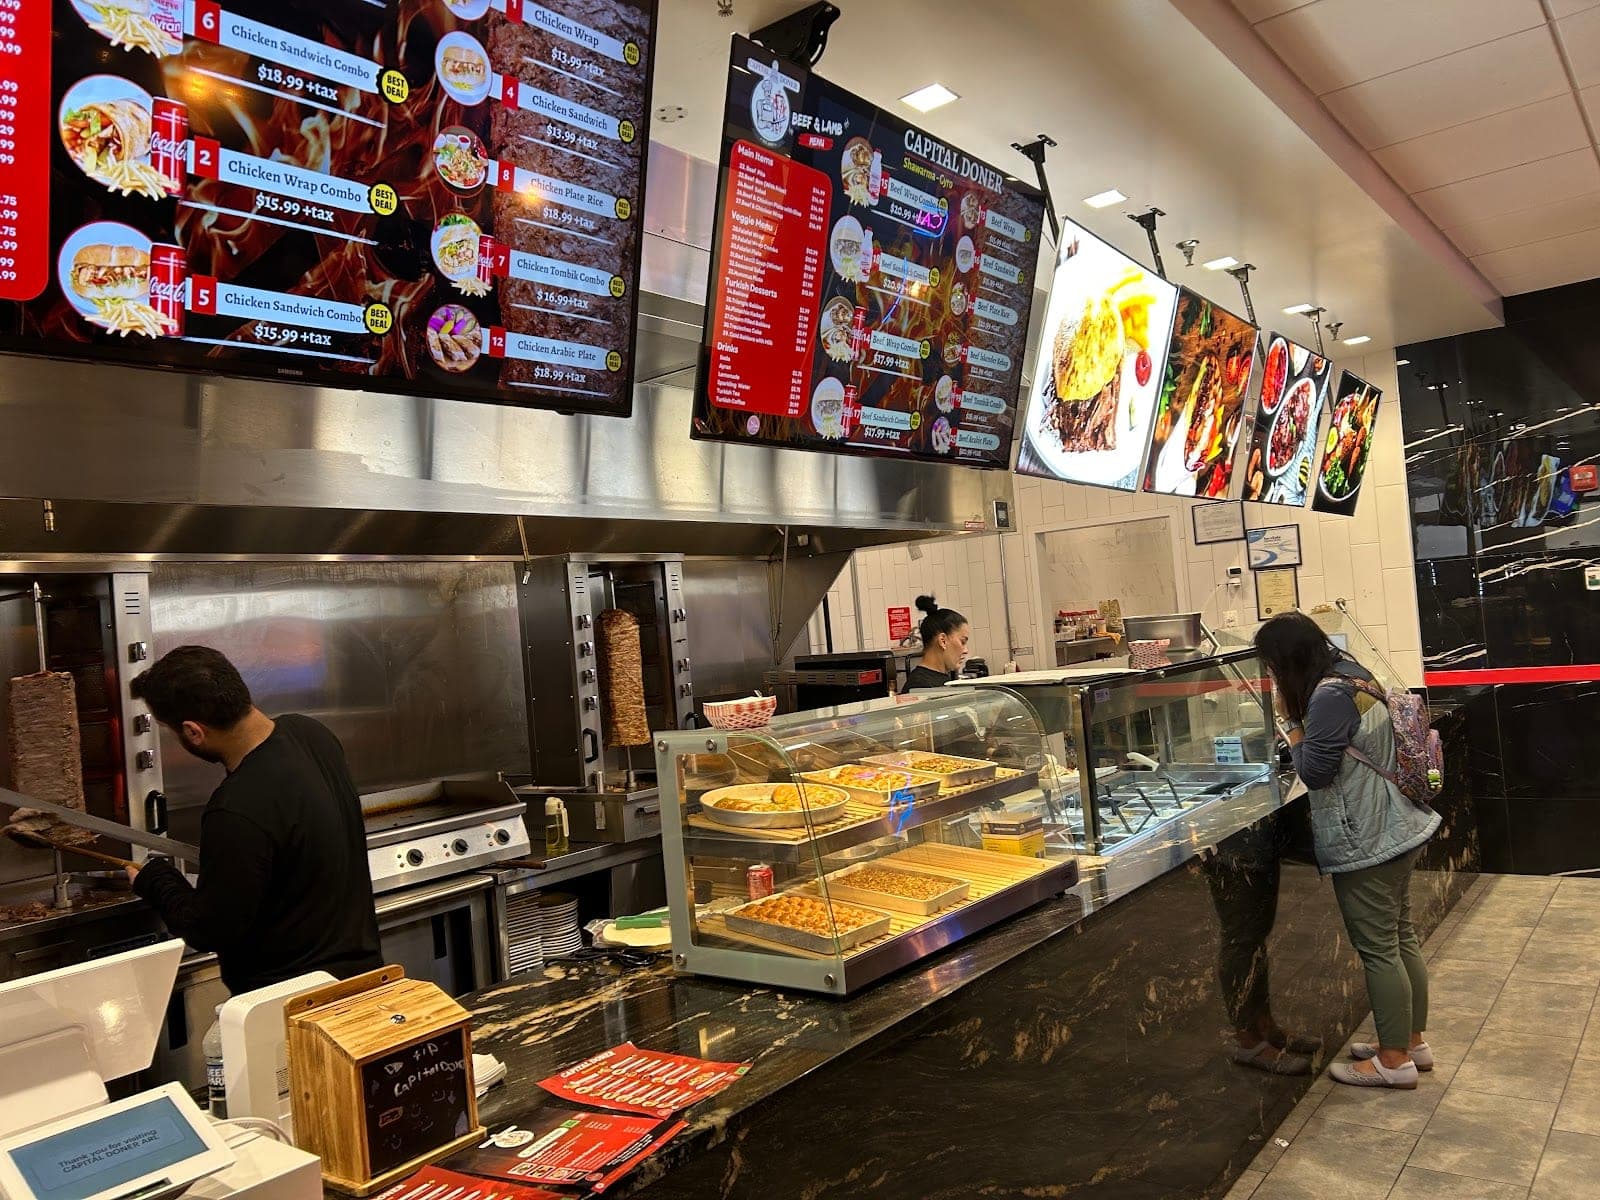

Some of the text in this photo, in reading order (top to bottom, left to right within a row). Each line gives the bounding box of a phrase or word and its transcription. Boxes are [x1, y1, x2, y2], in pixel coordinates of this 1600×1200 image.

[534, 10, 572, 36] Chicken
[574, 24, 599, 48] Wrap
[202, 12, 371, 81] 6 Chicken Sandwich Combo
[626, 44, 638, 55] BEST
[551, 46, 605, 78] $13.99 +tax
[257, 64, 338, 102] $18.99 +tax
[386, 72, 406, 86] BEST
[386, 85, 406, 99] DEAL
[506, 86, 607, 131] 4 Chicken Sandwich
[621, 122, 633, 132] BEST
[791, 111, 844, 136] BEEF & LAMB
[546, 123, 599, 151] $13.99 +tax
[809, 136, 825, 148] MENU
[737, 144, 755, 161] Main
[755, 152, 774, 167] Items
[904, 129, 1004, 195] CAPITAL DONER
[199, 150, 361, 203] 2 Chicken Wrap Combo
[903, 157, 936, 182] Shawarma
[939, 174, 953, 190] Gyro
[374, 187, 394, 201] BEST
[502, 169, 604, 208] 8 Chicken Plate Rice
[881, 178, 888, 189] 15
[890, 182, 902, 196] Beef
[904, 189, 918, 205] Wrap
[919, 197, 939, 210] Combo
[256, 191, 334, 223] $15.99 +tax
[374, 198, 394, 212] DEAL
[890, 202, 912, 220] $20.99
[543, 205, 596, 229] $18.99 +tax
[731, 209, 774, 232] Veggie Menu
[991, 215, 1002, 227] Beef
[1003, 221, 1016, 234] Wrap
[498, 255, 505, 268] 7
[516, 258, 549, 275] Chicken
[550, 265, 579, 281] Tombik
[579, 272, 606, 287] Combo
[881, 259, 892, 269] Beef
[983, 257, 994, 268] Beef
[994, 262, 1016, 277] Sandwich
[725, 277, 750, 291] Turkish
[750, 284, 778, 299] Desserts
[197, 289, 362, 324] 5 Chicken Sandwich Combo
[370, 307, 389, 320] BEST
[977, 301, 988, 312] Beef
[254, 323, 332, 346] $15.99 +tax
[370, 317, 389, 330] DEAL
[492, 336, 597, 362] 12 Chicken Arabic Plate
[717, 341, 739, 354] Drinks
[863, 333, 870, 342] 14
[872, 335, 885, 346] Beef
[886, 338, 900, 350] Wrap
[900, 341, 919, 353] Combo
[873, 353, 894, 366] $17.99
[970, 351, 980, 360] Beef
[533, 367, 586, 384] $18.99 +tax
[854, 409, 861, 418] 17
[861, 411, 873, 421] Beef
[873, 413, 893, 423] Sandwich
[893, 416, 910, 425] Combo
[864, 426, 885, 439] $17.99
[57, 1129, 158, 1168] Thank you for visiting
[62, 1156, 105, 1173] CAPITAL
[106, 1142, 141, 1158] DONER
